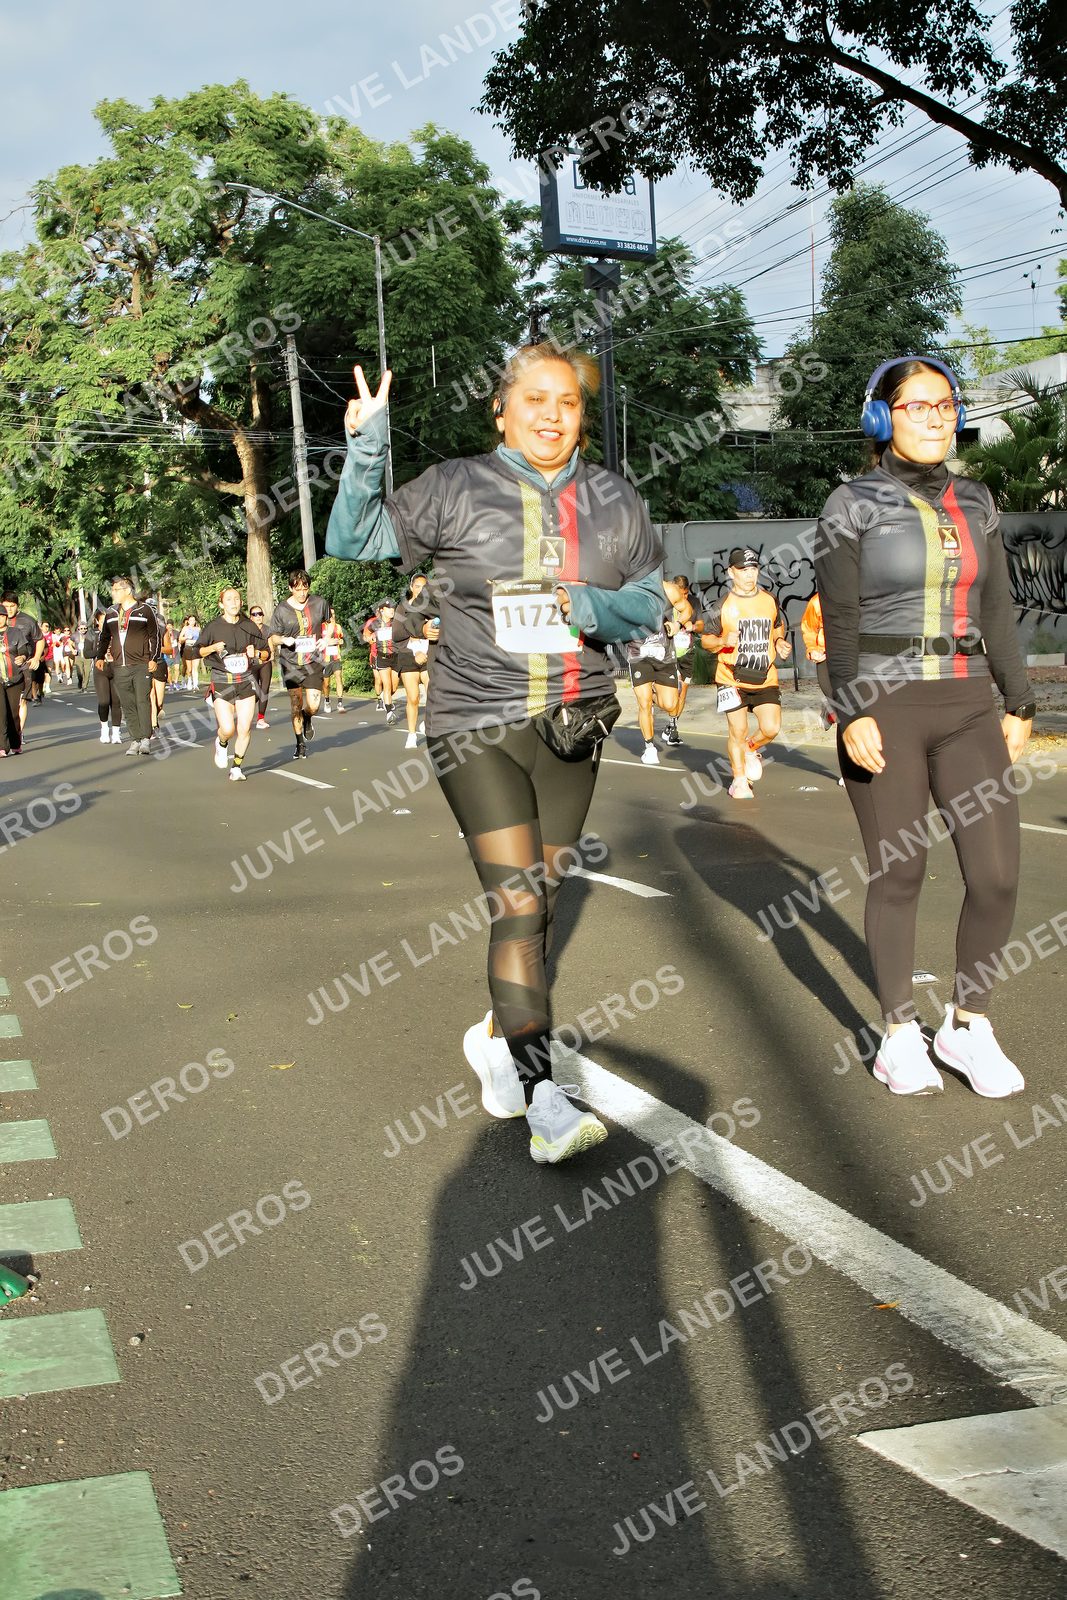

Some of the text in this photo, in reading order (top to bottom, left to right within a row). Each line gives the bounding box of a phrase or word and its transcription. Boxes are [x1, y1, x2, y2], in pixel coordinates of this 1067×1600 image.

[566, 236, 607, 246] www.dibra.com.mx
[624, 242, 636, 250] 3826
[637, 243, 649, 251] 4845
[499, 603, 568, 628] 1172
